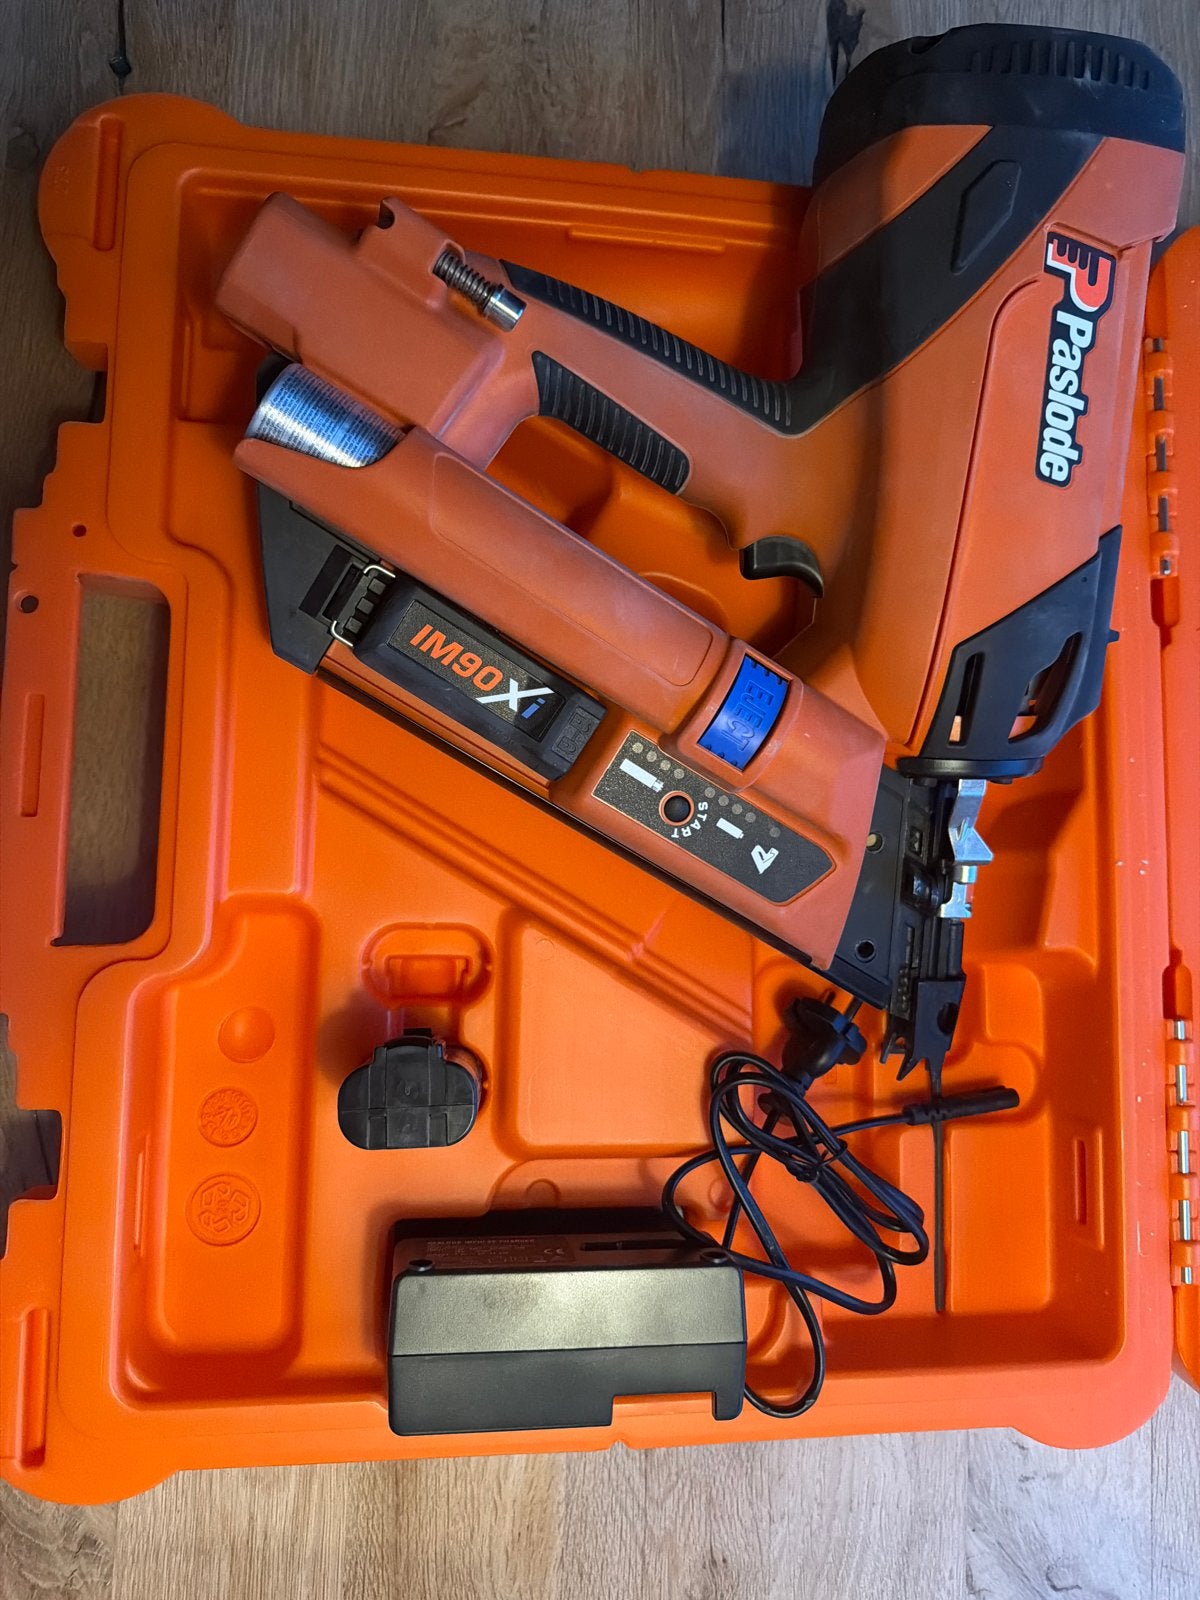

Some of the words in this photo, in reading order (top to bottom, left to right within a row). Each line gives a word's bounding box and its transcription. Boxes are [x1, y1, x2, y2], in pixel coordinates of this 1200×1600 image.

[1039, 310, 1093, 482] Paslode
[721, 679, 774, 752] EJECT
[671, 801, 708, 838] START
